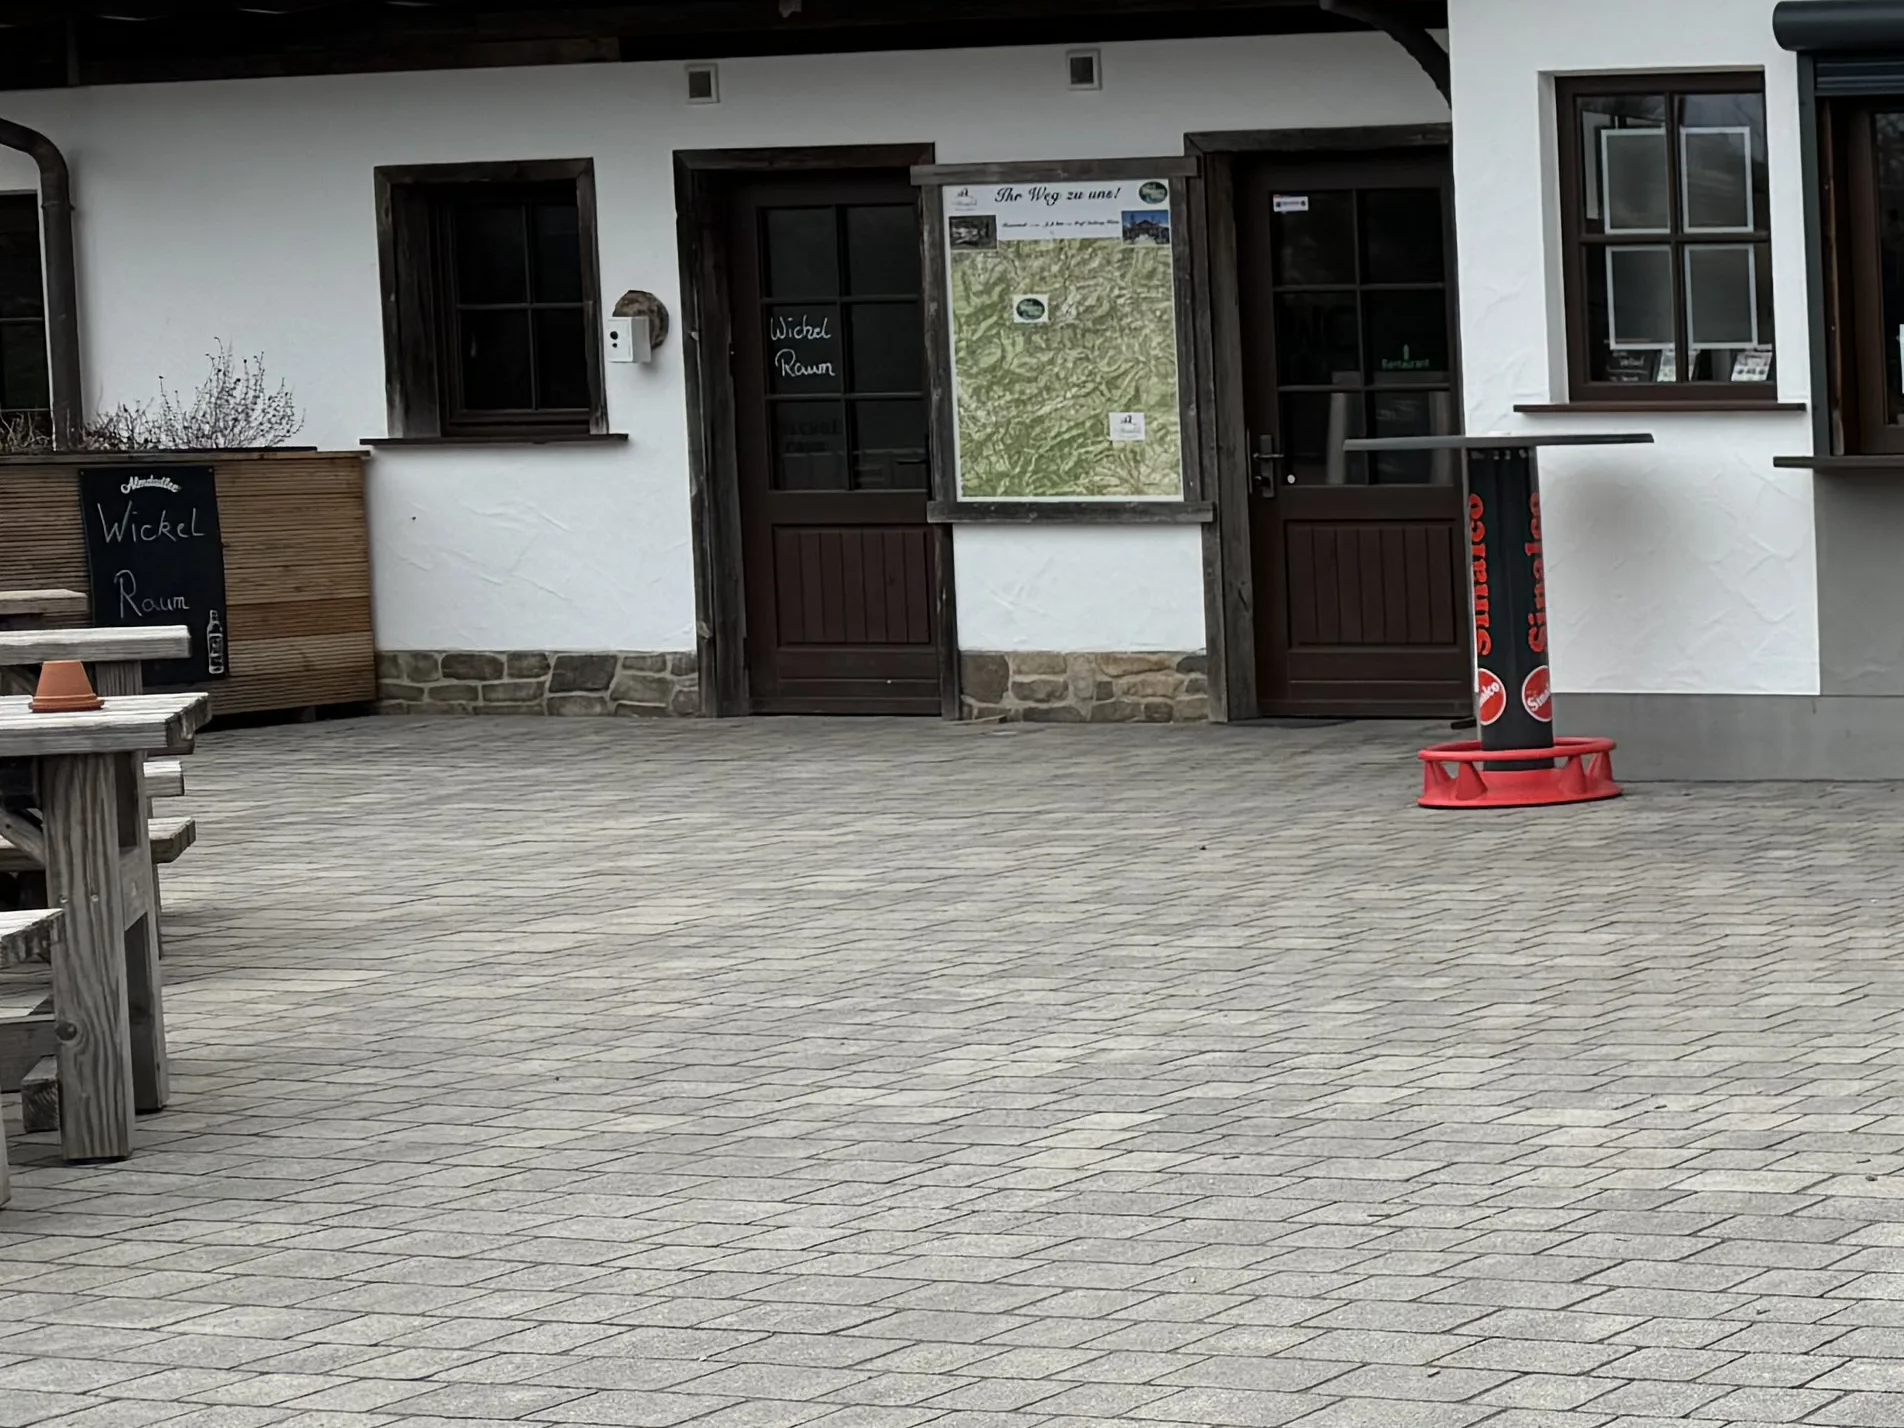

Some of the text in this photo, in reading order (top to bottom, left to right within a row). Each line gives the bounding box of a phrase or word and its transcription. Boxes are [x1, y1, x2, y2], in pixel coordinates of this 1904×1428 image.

[1028, 186, 1060, 206] Weg
[1066, 190, 1084, 201] zu
[775, 348, 836, 377] Raum
[114, 569, 190, 619] Raum
